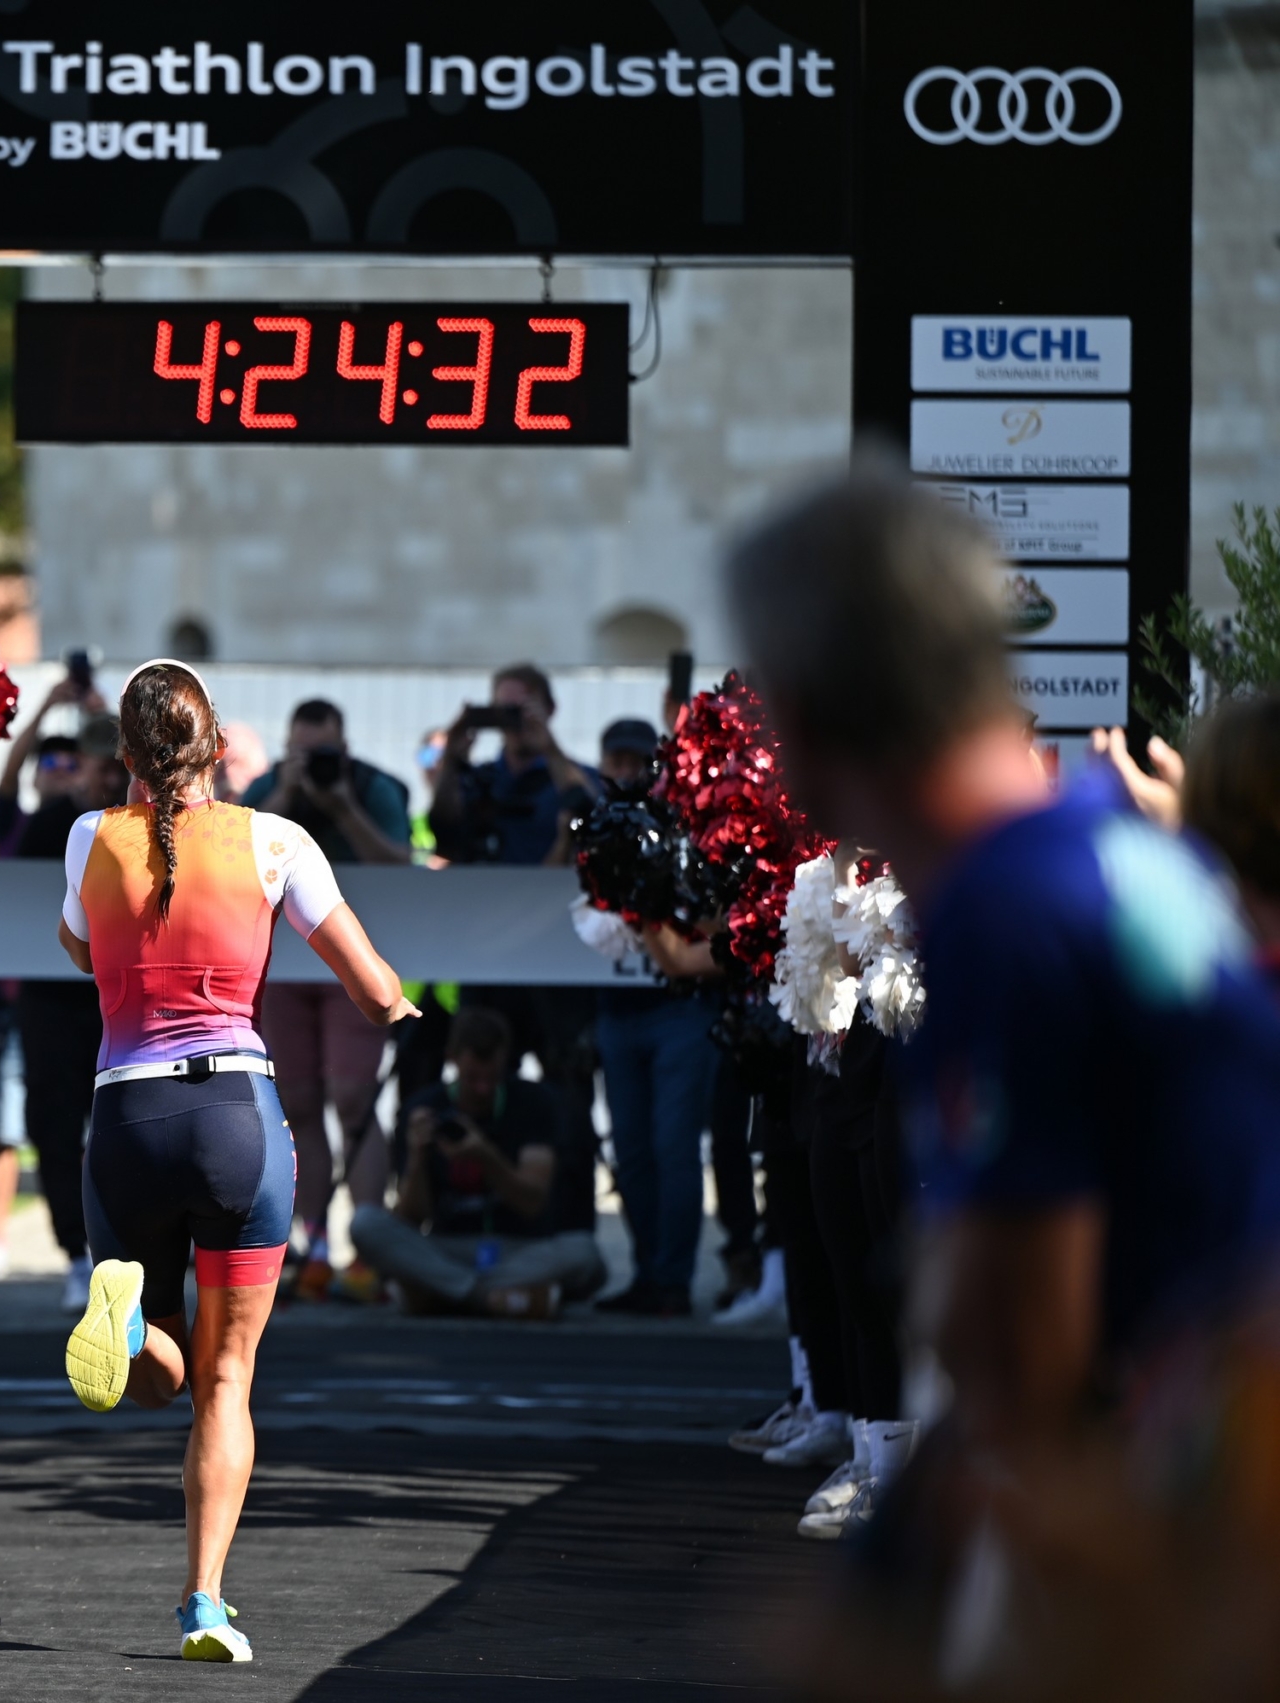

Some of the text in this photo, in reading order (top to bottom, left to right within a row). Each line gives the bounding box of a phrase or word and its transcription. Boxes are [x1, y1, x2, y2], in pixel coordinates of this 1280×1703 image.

[3, 41, 376, 95] Triathlon
[406, 43, 835, 110] Ingolstadt
[49, 122, 221, 161] BÜCHL
[941, 326, 1101, 362] BÜCHL
[974, 366, 1101, 382] SUSTAINABLE FUTURE
[930, 453, 1015, 474] JUWELIER
